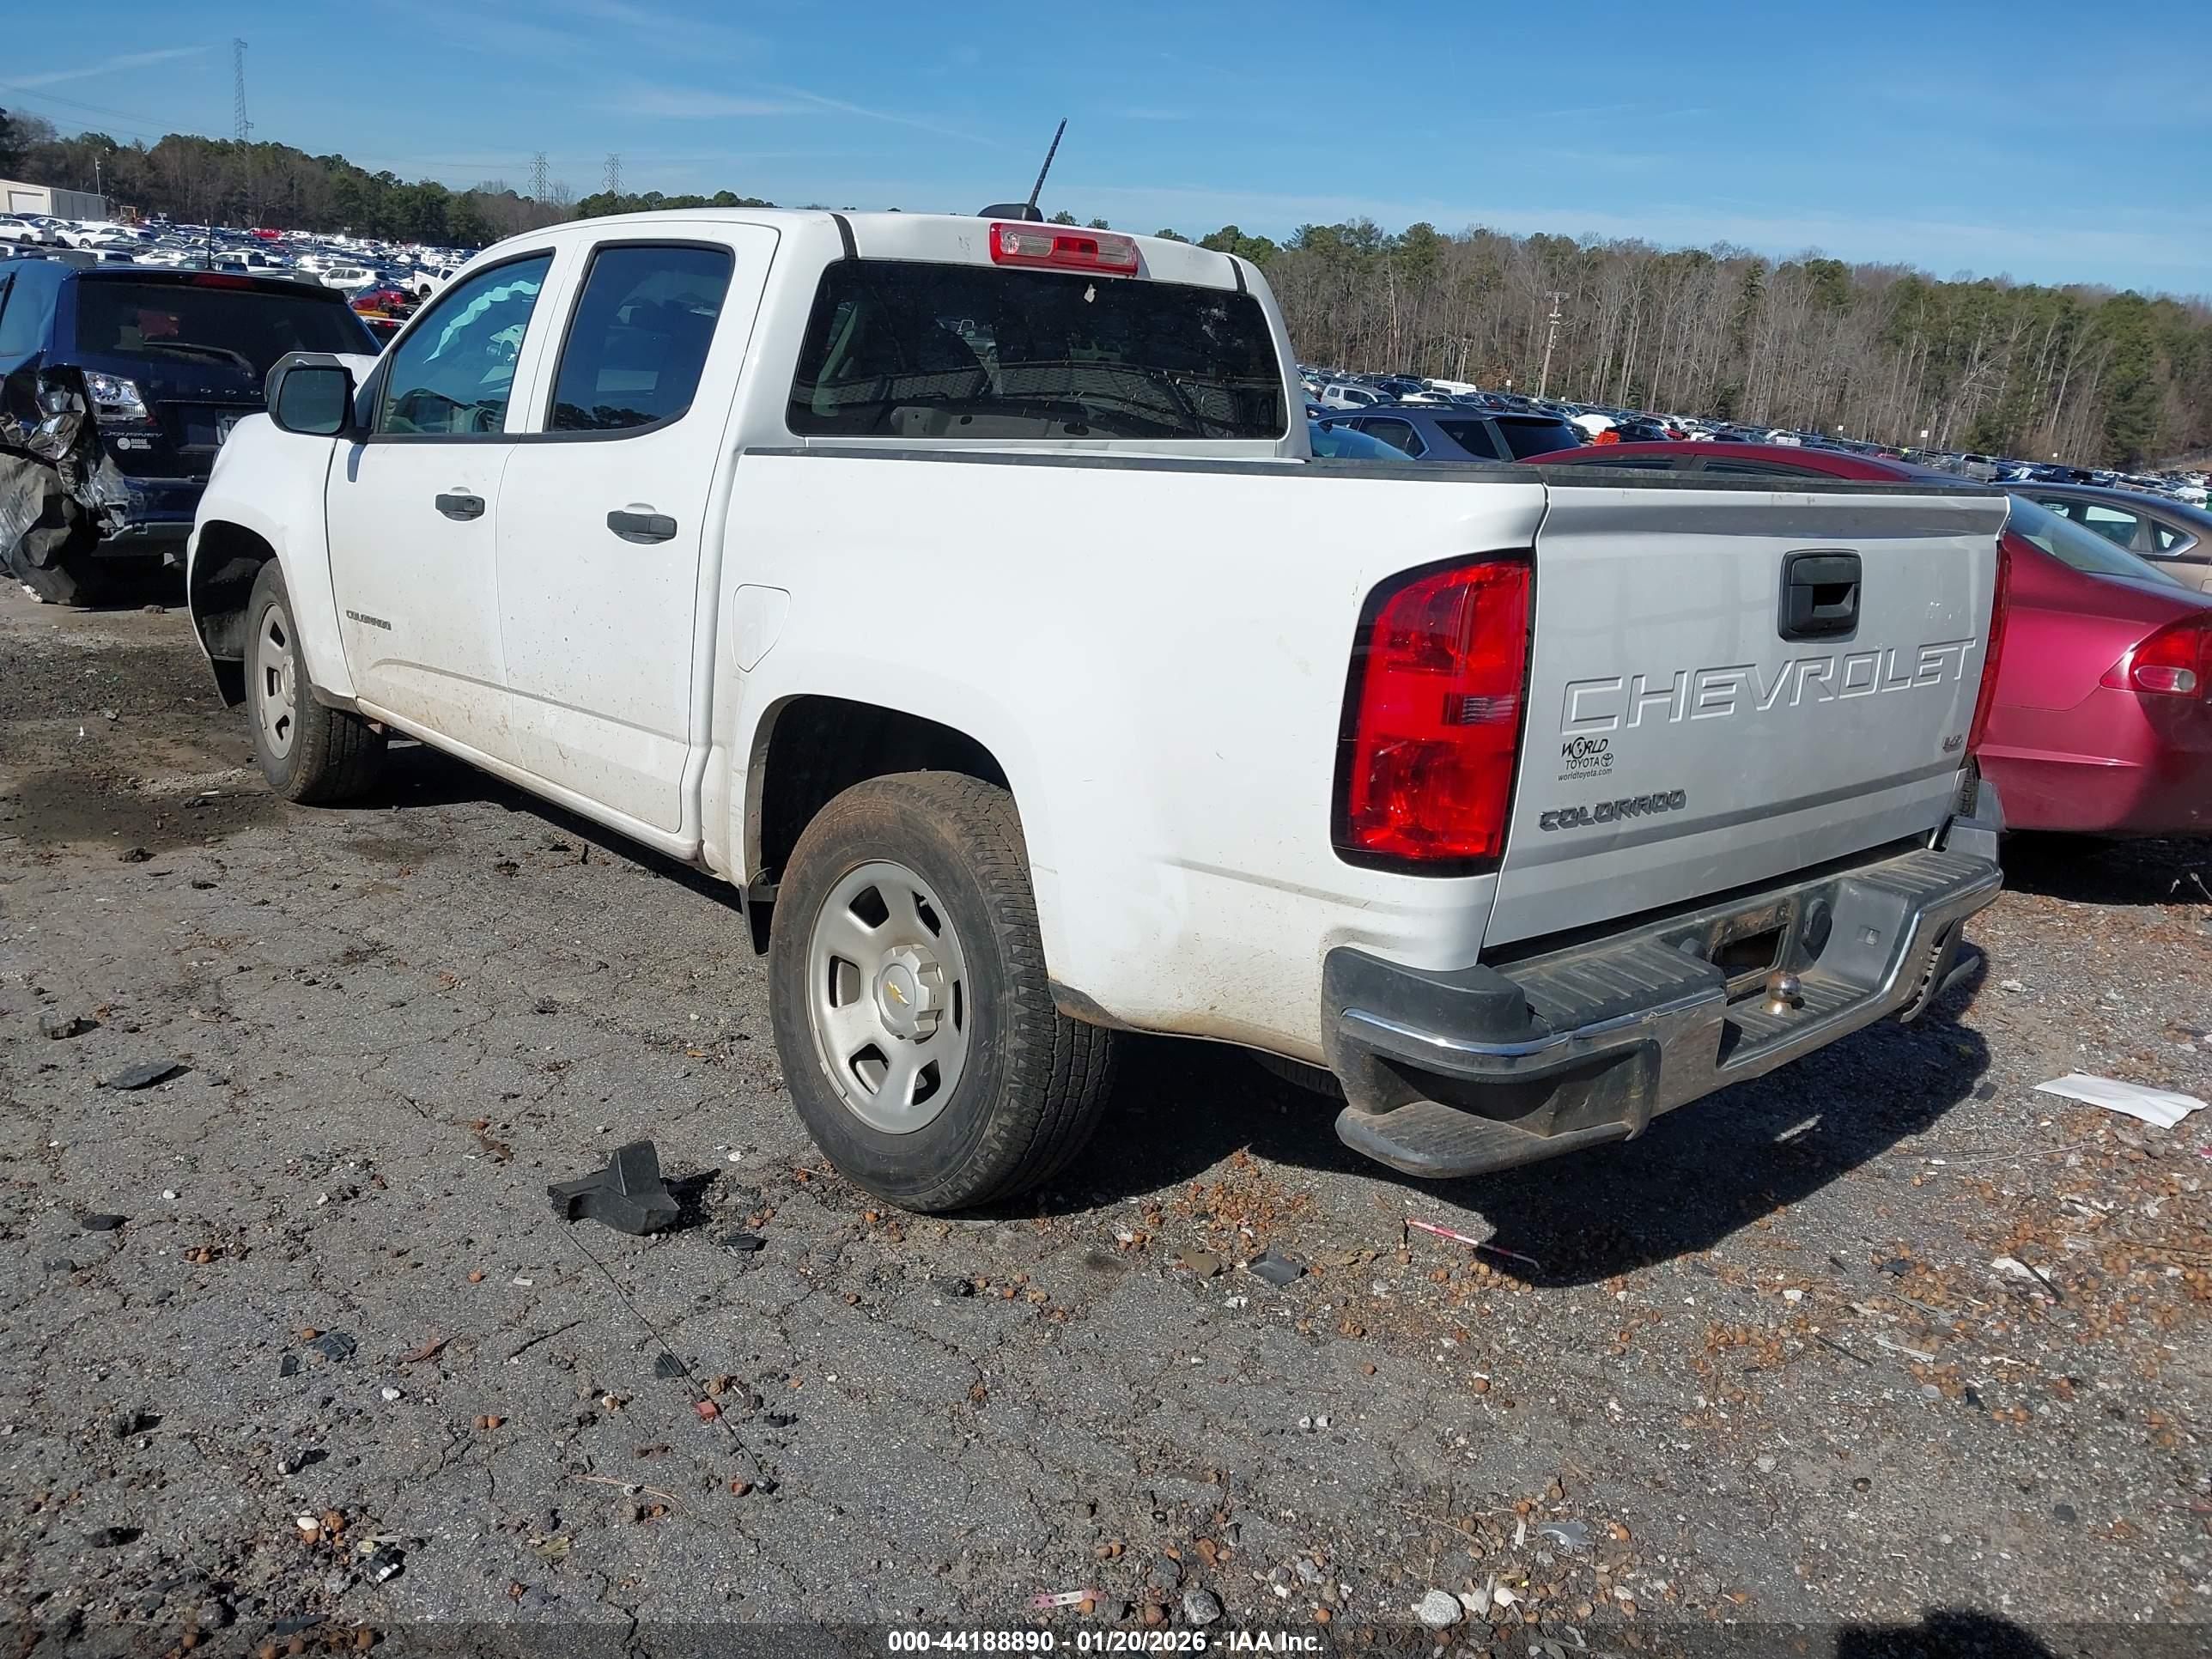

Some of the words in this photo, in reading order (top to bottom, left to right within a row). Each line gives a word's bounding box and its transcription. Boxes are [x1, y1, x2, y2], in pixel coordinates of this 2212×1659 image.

[345, 609, 392, 631] COLORADO
[1559, 637, 1976, 736] CHEVROLET
[1561, 736, 1609, 759] WORLD
[1558, 768, 1613, 781] worldtoyota.com
[1565, 757, 1601, 770] TOYOTA
[1539, 788, 1687, 832] COLORADO
